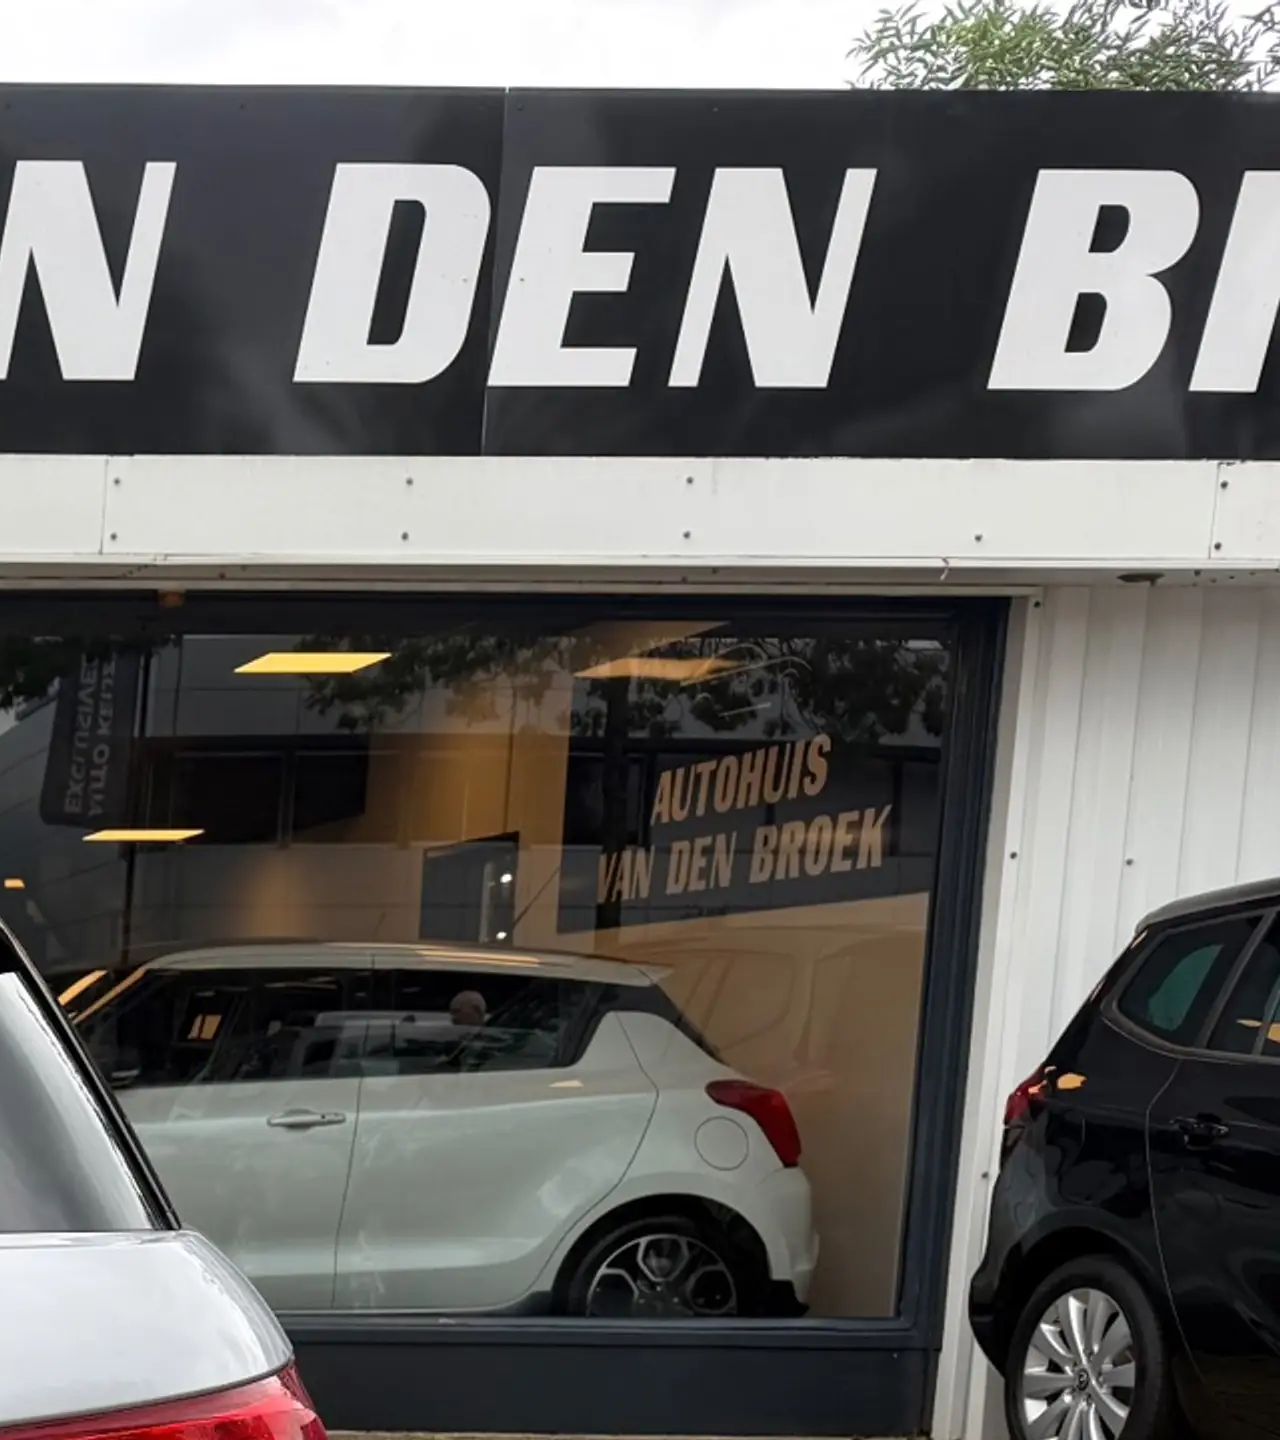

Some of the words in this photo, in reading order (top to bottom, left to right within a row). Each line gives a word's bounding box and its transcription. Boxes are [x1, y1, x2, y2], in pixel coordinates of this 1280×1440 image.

[293, 162, 878, 390] DEN
[650, 733, 832, 826] AUTOHUIS
[596, 846, 656, 904] VAN
[665, 830, 738, 895] DEN
[748, 804, 893, 884] BROEK
